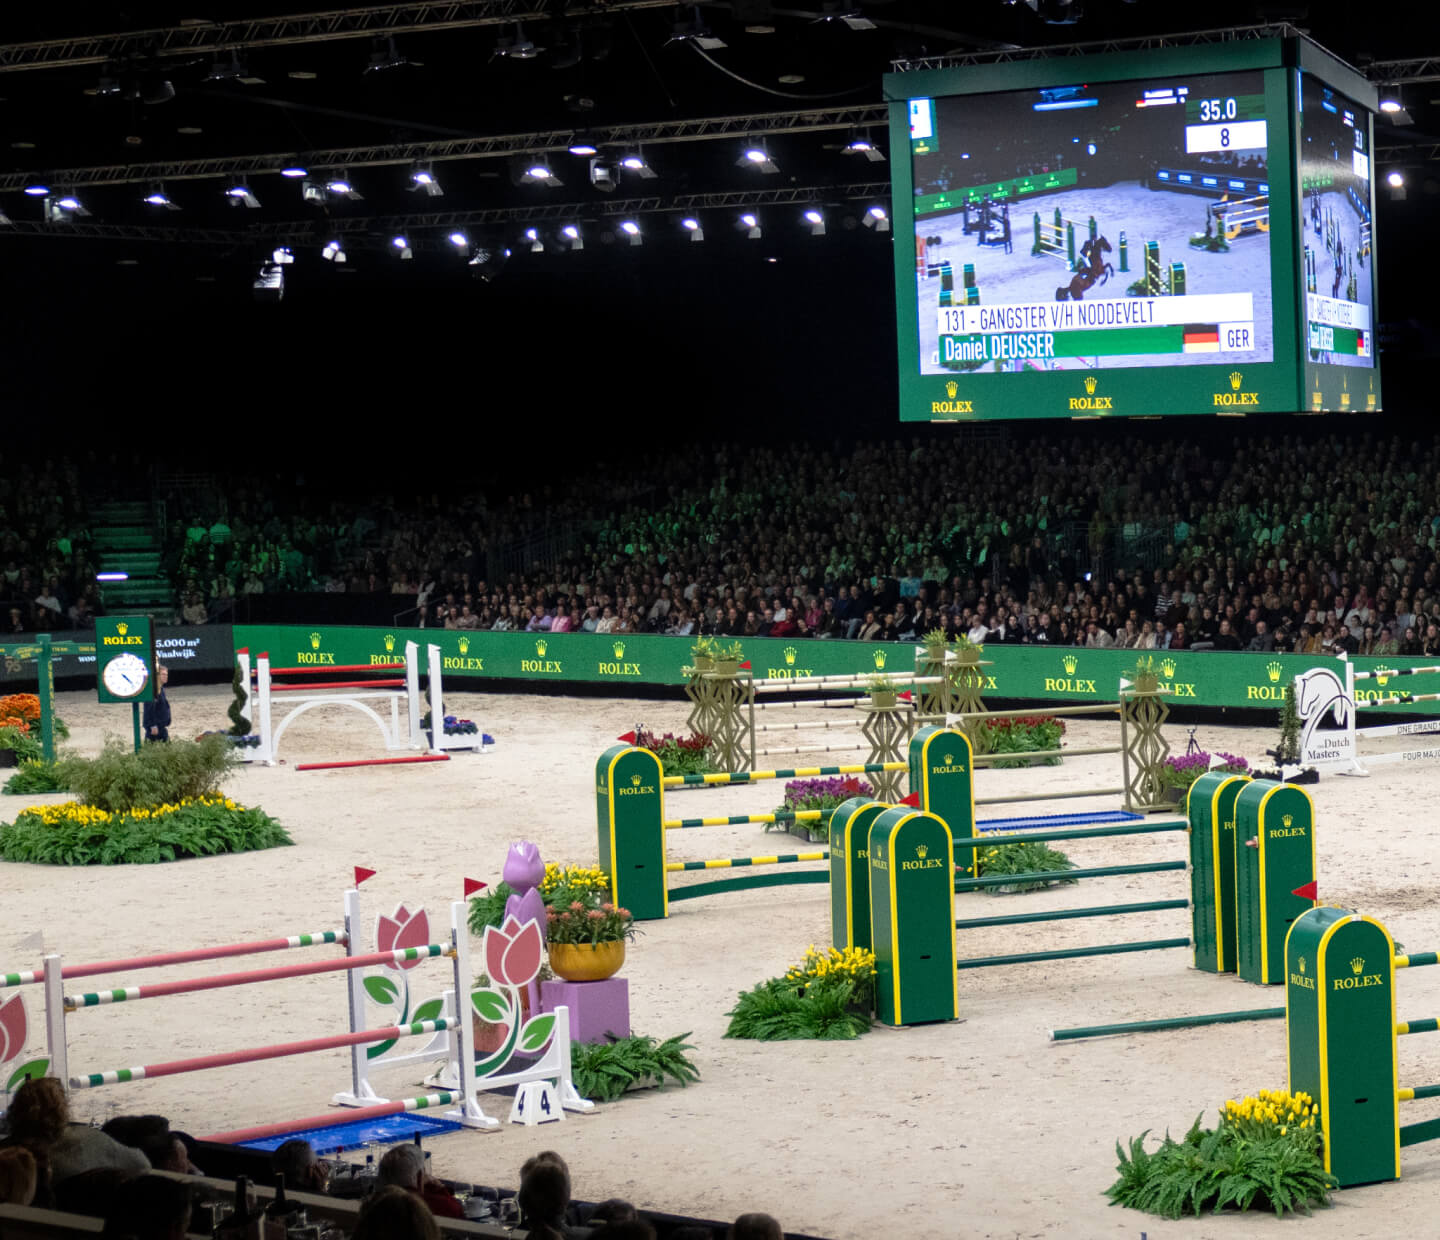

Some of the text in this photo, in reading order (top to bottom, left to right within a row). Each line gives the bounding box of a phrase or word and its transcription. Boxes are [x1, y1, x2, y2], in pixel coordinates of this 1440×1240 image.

[1200, 98, 1236, 121] 35.0
[1220, 128, 1230, 147] 8
[945, 310, 965, 331] 131
[980, 306, 1046, 330] GANGSTER
[1051, 304, 1073, 327] V/H
[1078, 301, 1154, 325] NODDEVELT
[1227, 329, 1249, 348] GER
[945, 333, 1054, 361] Daniel DEUSSER
[1069, 396, 1113, 410] ROLEX
[1213, 392, 1259, 406] ROLEX
[932, 401, 973, 413] ROLEX
[103, 636, 143, 645] ROLEX
[297, 652, 335, 664] ROLEX
[443, 656, 483, 670] ROLEX
[521, 659, 562, 673] ROLEX
[598, 662, 641, 675] ROLEX
[1045, 678, 1096, 693] ROLEX
[1397, 724, 1412, 735] ONE
[1413, 722, 1437, 732] GRAND
[1325, 737, 1350, 749] Dutch
[1308, 750, 1340, 760] Masters
[1403, 751, 1421, 761] FOUR
[933, 765, 965, 775] ROLEX
[619, 786, 656, 796] ROLEX
[1270, 827, 1306, 838] ROLEX
[902, 858, 943, 870] ROLEX
[1291, 973, 1315, 990] ROLEX
[1333, 974, 1383, 990] ROLEX
[518, 1090, 526, 1116] 4
[540, 1089, 550, 1115] 4
